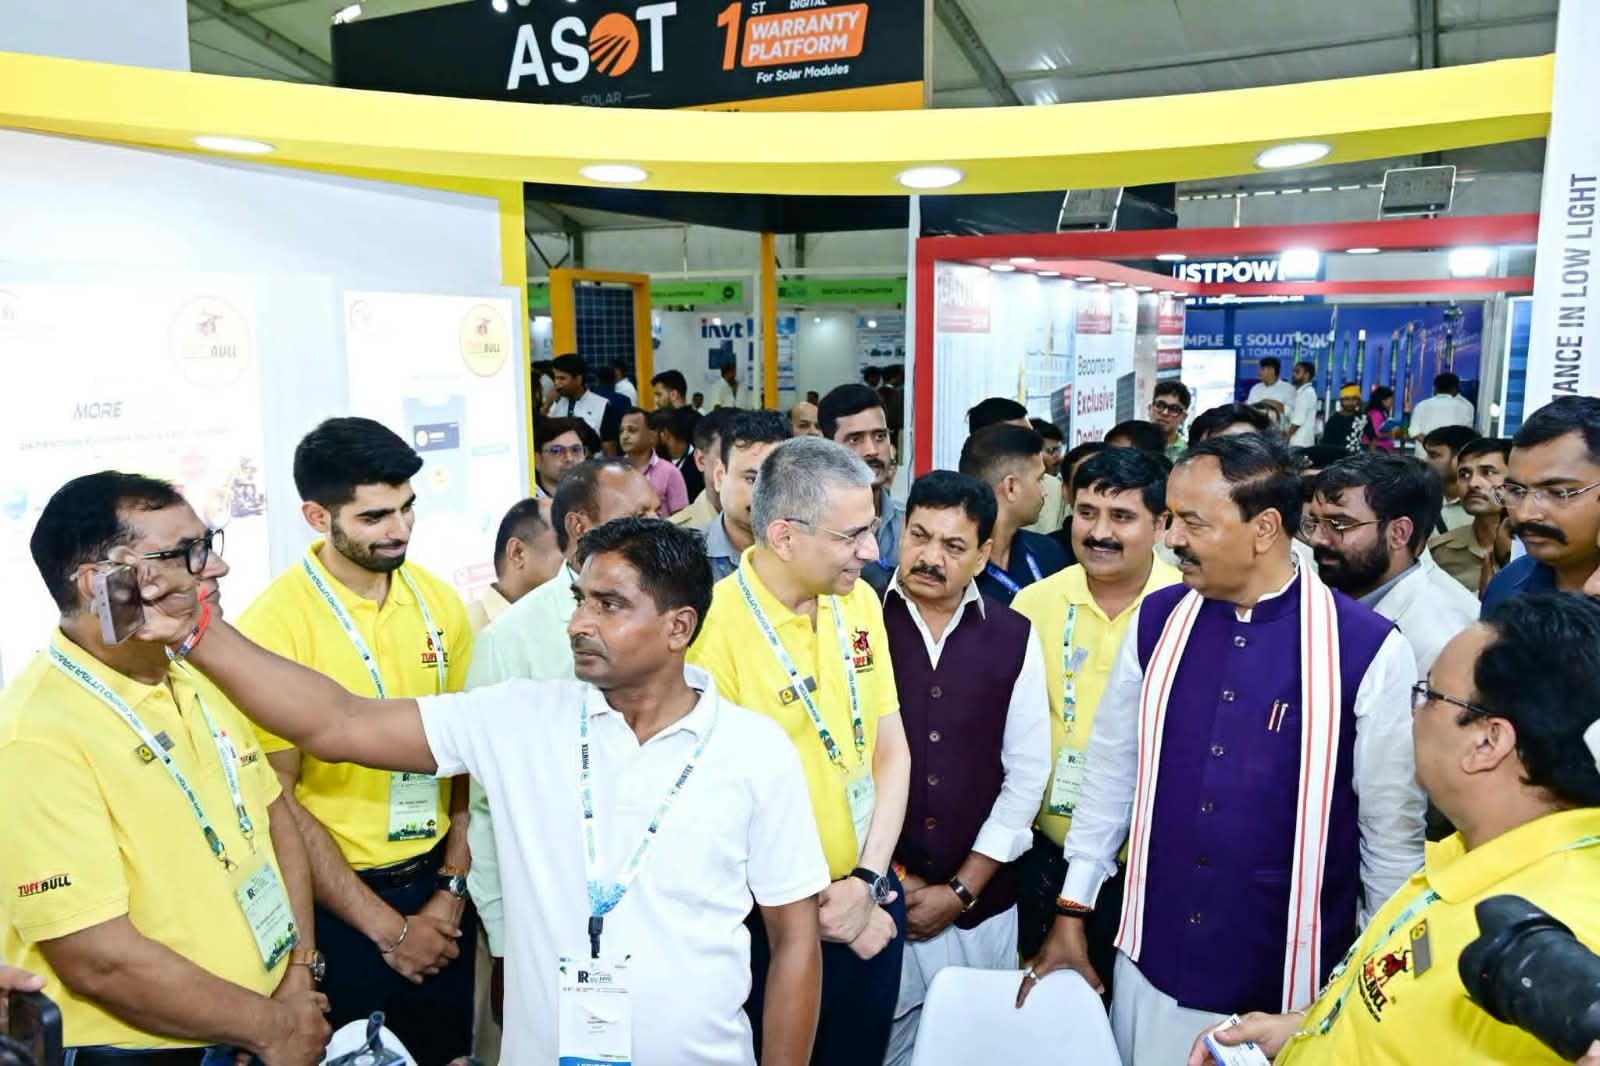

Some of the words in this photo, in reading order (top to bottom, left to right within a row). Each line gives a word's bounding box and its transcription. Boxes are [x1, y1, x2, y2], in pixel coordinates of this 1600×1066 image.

[751, 1, 766, 14] ST
[751, 11, 861, 41] WARRANTY
[506, 1, 677, 90] ASOT
[747, 33, 849, 61] PLATFORM
[756, 71, 774, 84] For
[775, 68, 802, 81] Solar
[803, 64, 850, 79] Modules
[1566, 173, 1598, 240] LIGHT
[1560, 248, 1591, 298] LOW
[1557, 305, 1586, 328] IN
[1551, 335, 1583, 401] ANCE
[72, 400, 124, 421] MORE
[1077, 385, 1115, 416] Exclusive
[74, 668, 106, 694] UTTAR
